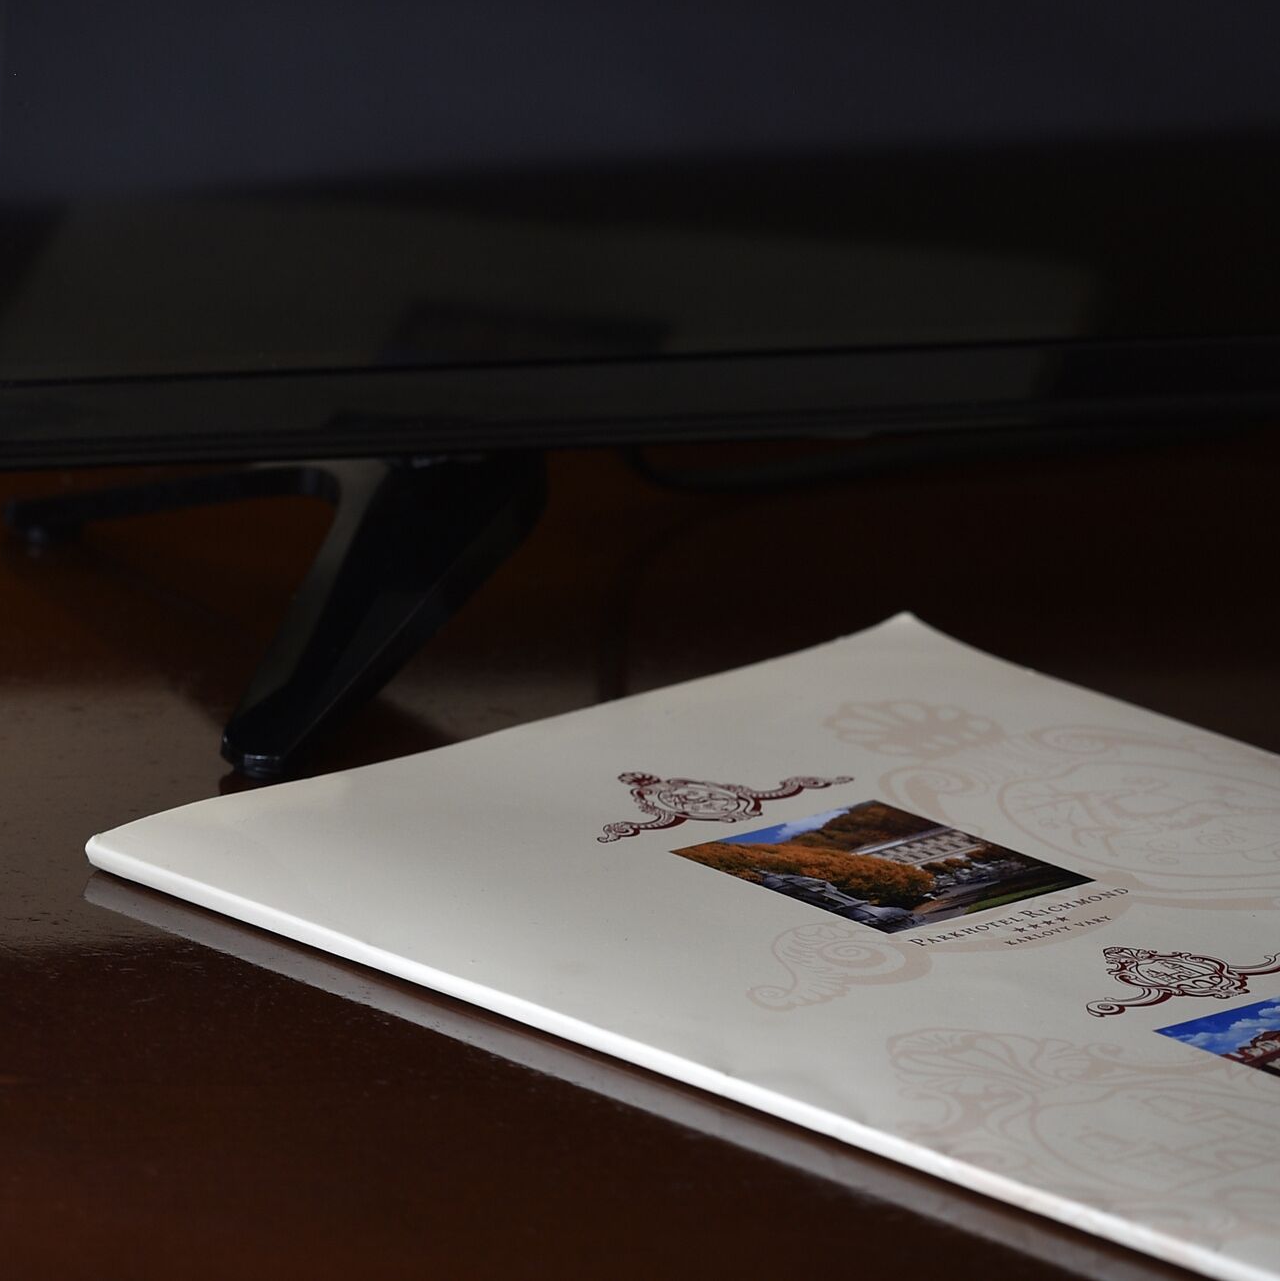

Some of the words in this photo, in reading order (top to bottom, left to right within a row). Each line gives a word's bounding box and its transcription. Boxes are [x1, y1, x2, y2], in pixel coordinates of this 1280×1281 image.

[908, 915, 1024, 947] PARKHOTEL
[1020, 887, 1130, 919] RICHMOND
[1003, 925, 1071, 947] KARLOVY
[1073, 915, 1113, 929] VARY
